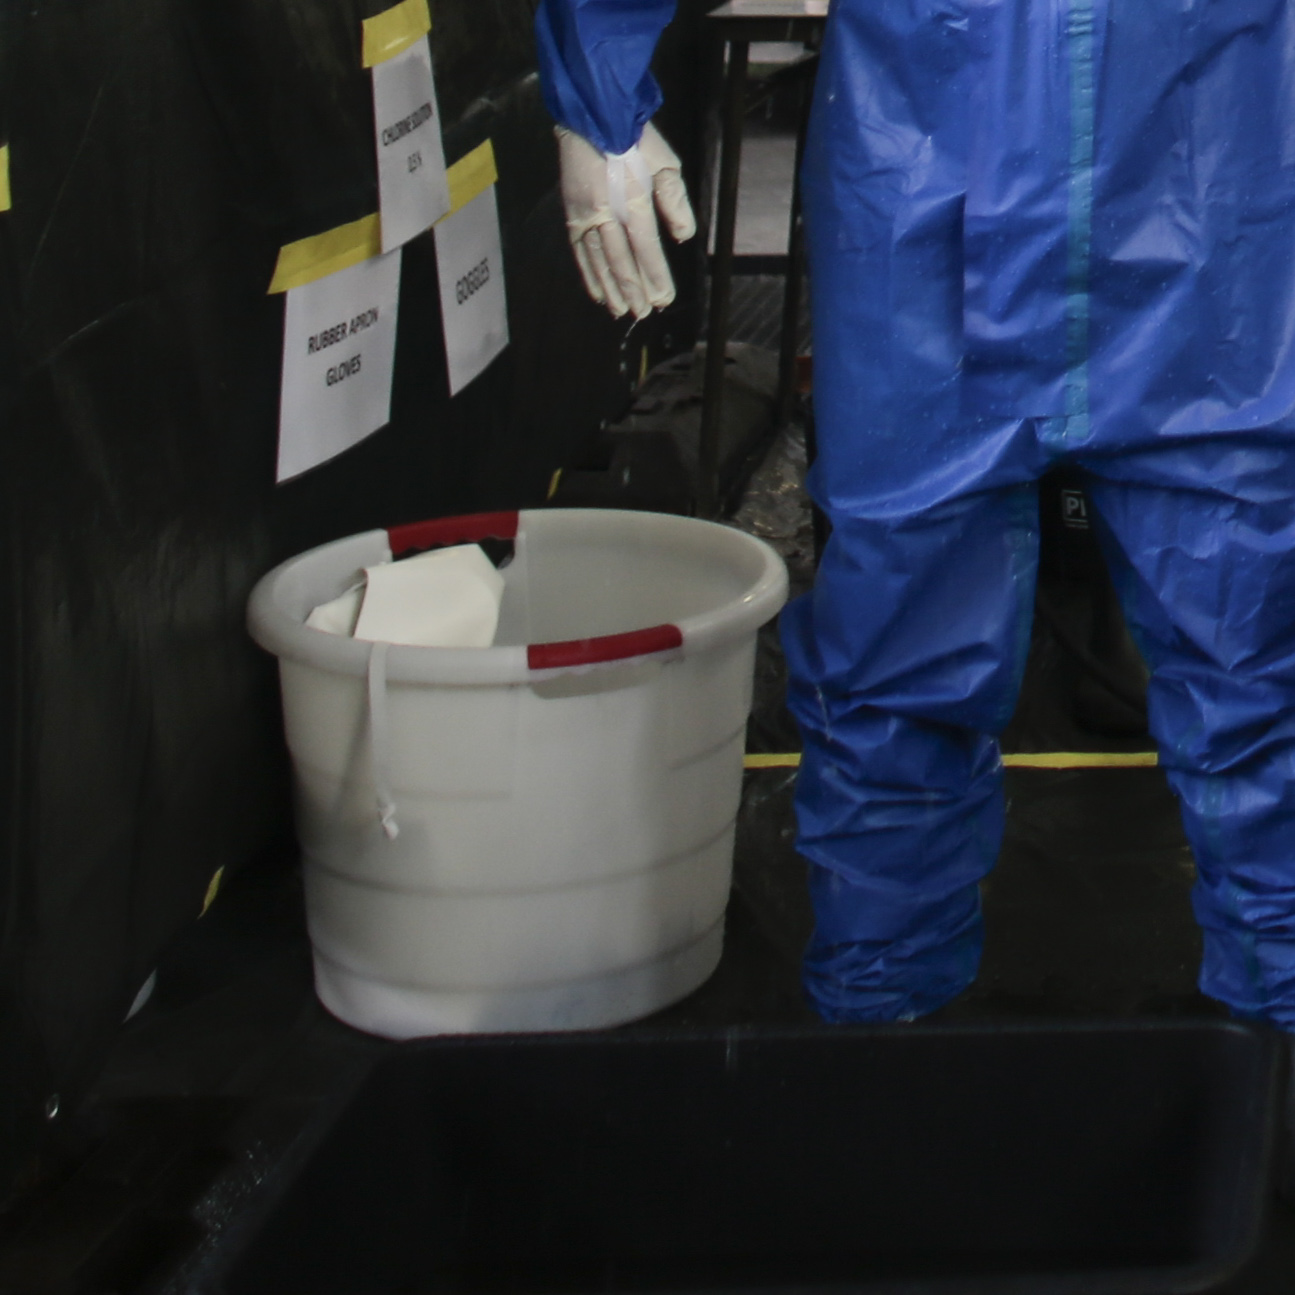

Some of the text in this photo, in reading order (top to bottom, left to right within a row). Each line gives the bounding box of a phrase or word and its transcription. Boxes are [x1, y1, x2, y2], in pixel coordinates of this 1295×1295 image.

[455, 257, 491, 305] GOGGLES
[307, 306, 379, 355] RUBBER APRON
[326, 354, 362, 387] GLOVES
